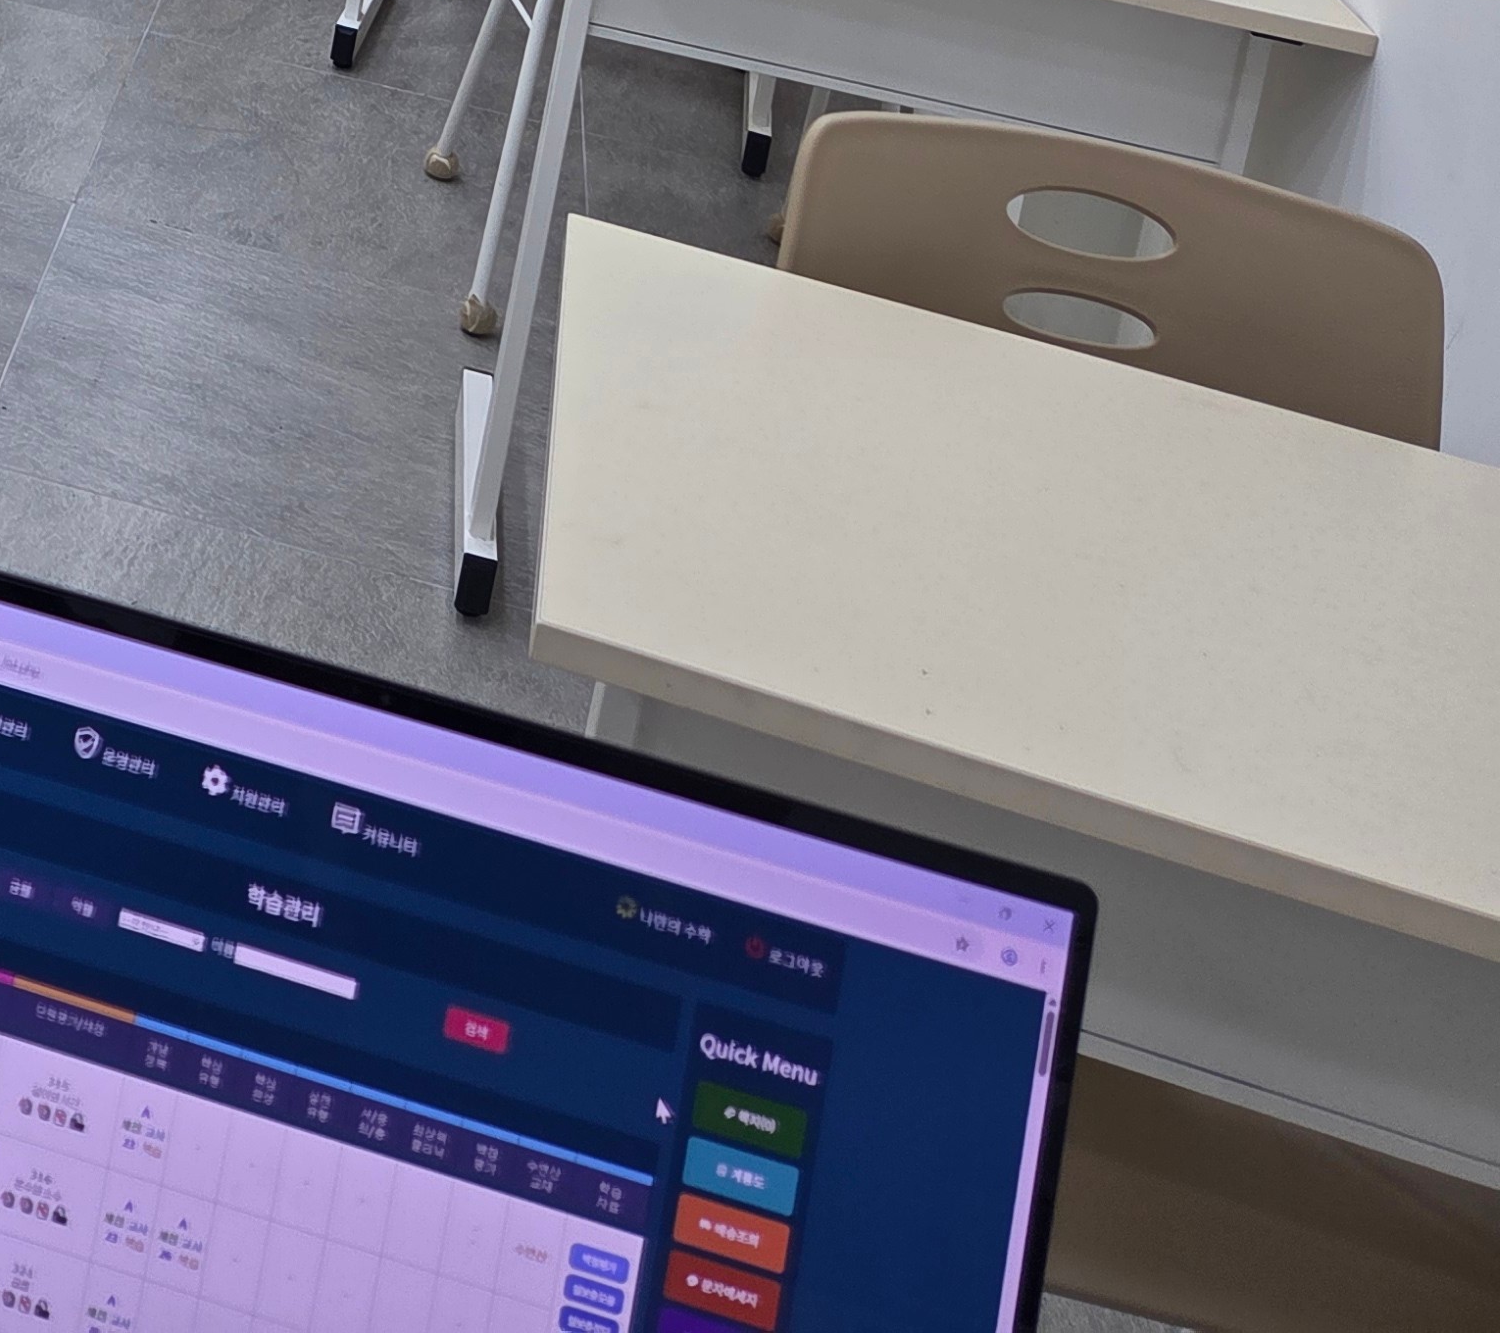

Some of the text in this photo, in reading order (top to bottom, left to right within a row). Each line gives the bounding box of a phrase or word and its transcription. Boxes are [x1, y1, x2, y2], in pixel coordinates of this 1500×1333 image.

[246, 881, 322, 927] 학습관리
[701, 1033, 819, 1086] Quick Menu
